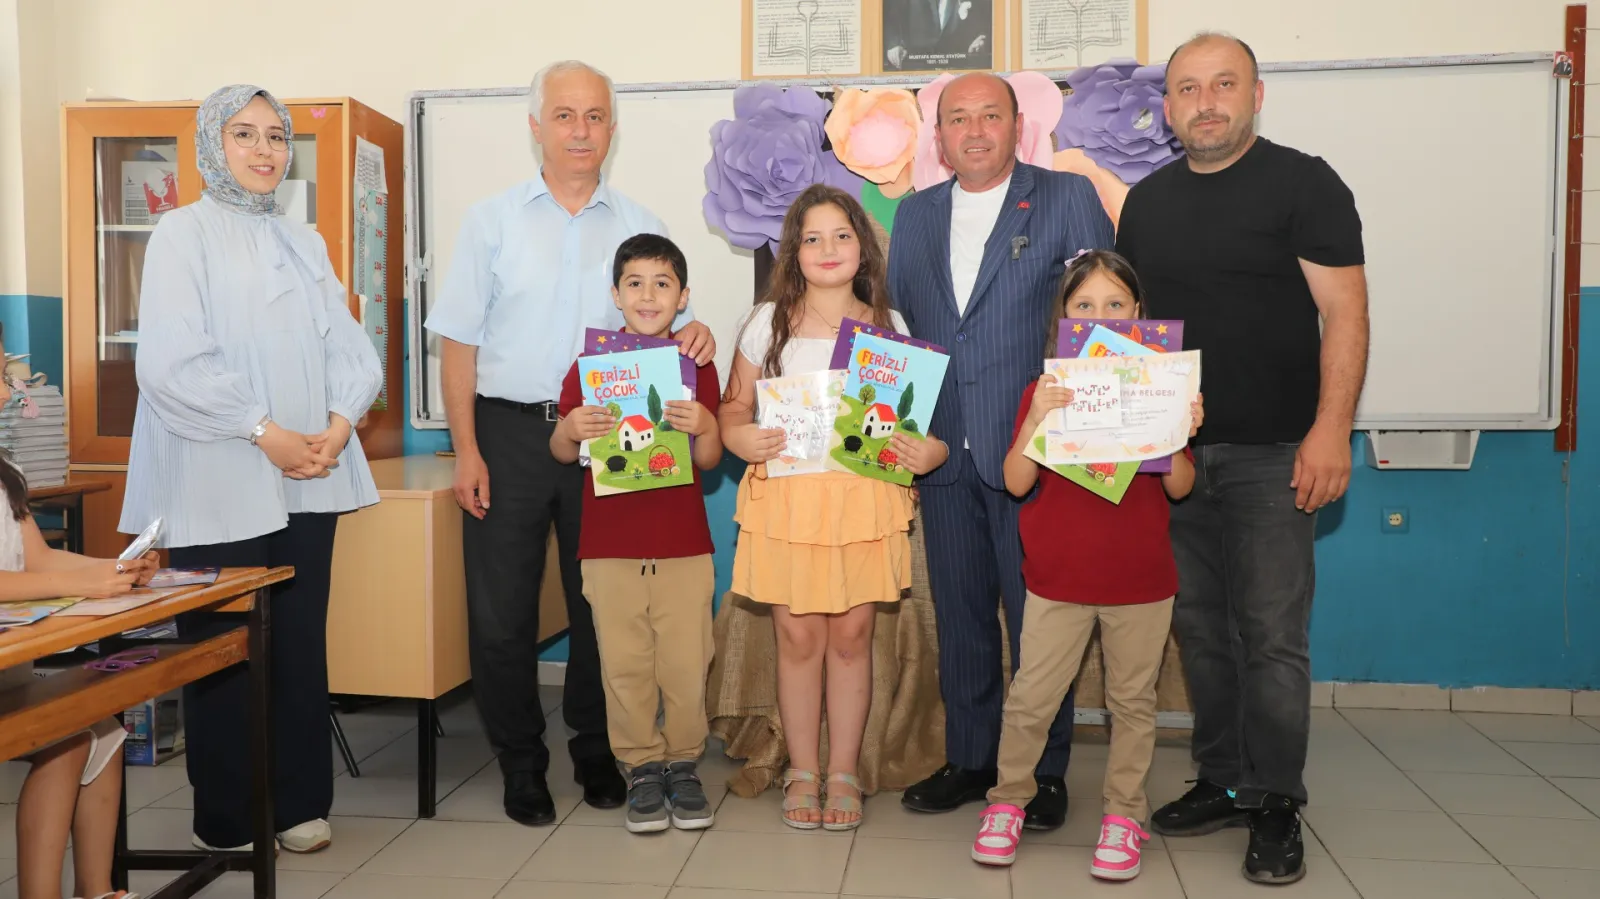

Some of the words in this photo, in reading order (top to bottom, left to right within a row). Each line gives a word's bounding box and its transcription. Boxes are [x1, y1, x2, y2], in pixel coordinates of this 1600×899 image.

[862, 350, 908, 373] FERİZLİ
[591, 363, 641, 385] FERİZLİ
[858, 365, 899, 386] ÇOCUK
[594, 383, 639, 405] ÇOCUK
